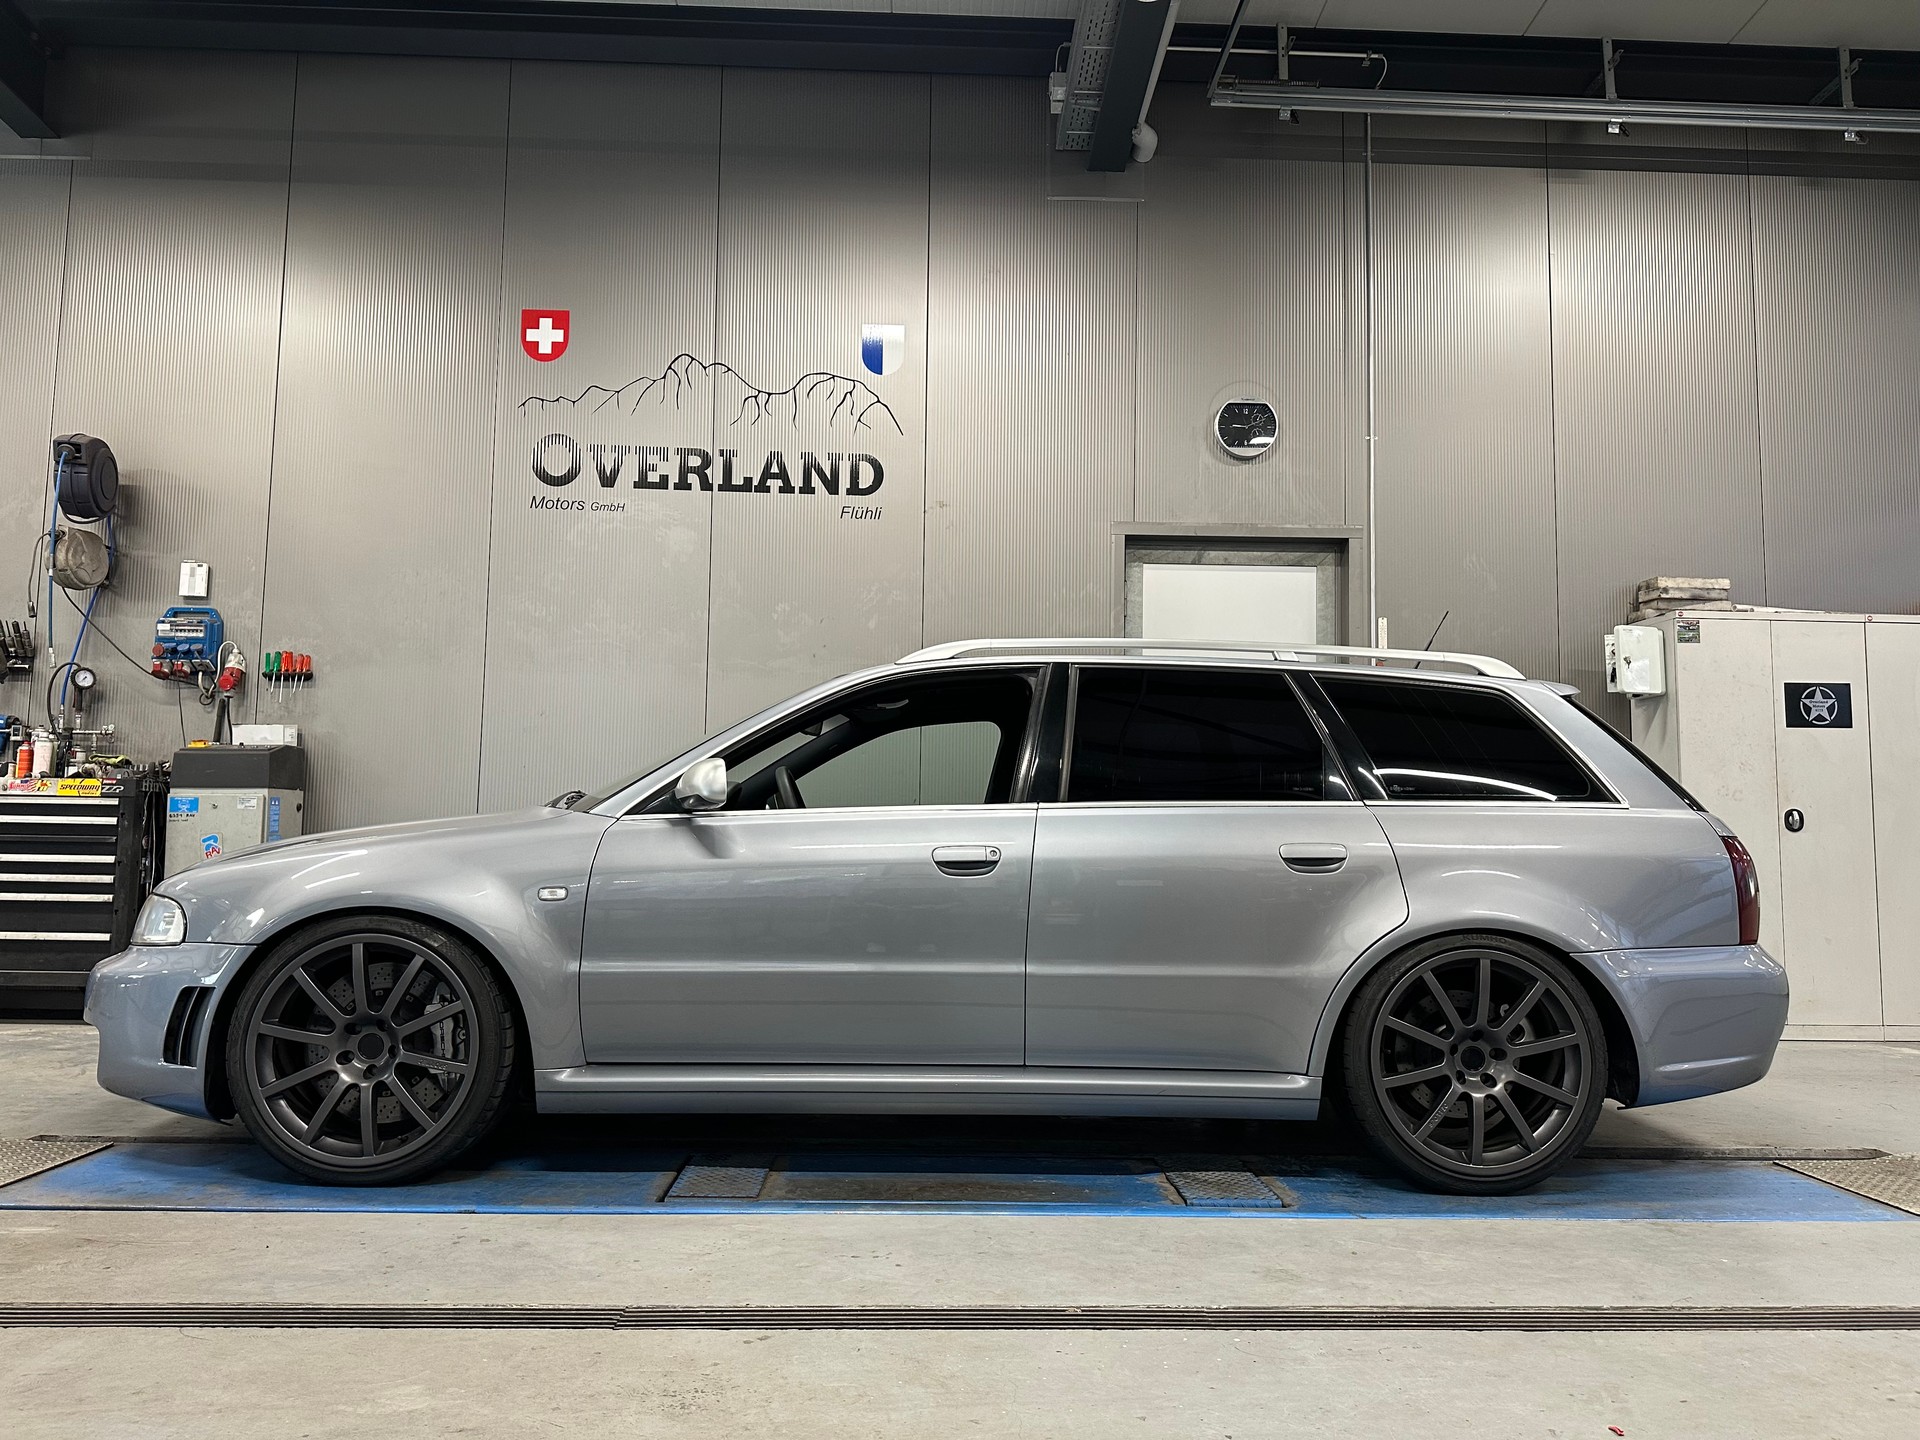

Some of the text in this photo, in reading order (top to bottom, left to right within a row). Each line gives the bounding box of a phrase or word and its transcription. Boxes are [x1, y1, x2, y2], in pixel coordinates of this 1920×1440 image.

[531, 432, 885, 497] OVERLAND
[530, 495, 626, 513] Motors GmbH
[839, 504, 883, 520] Flühli
[60, 784, 101, 792] SPEEDWAY
[1463, 933, 1507, 945] KUMHO
